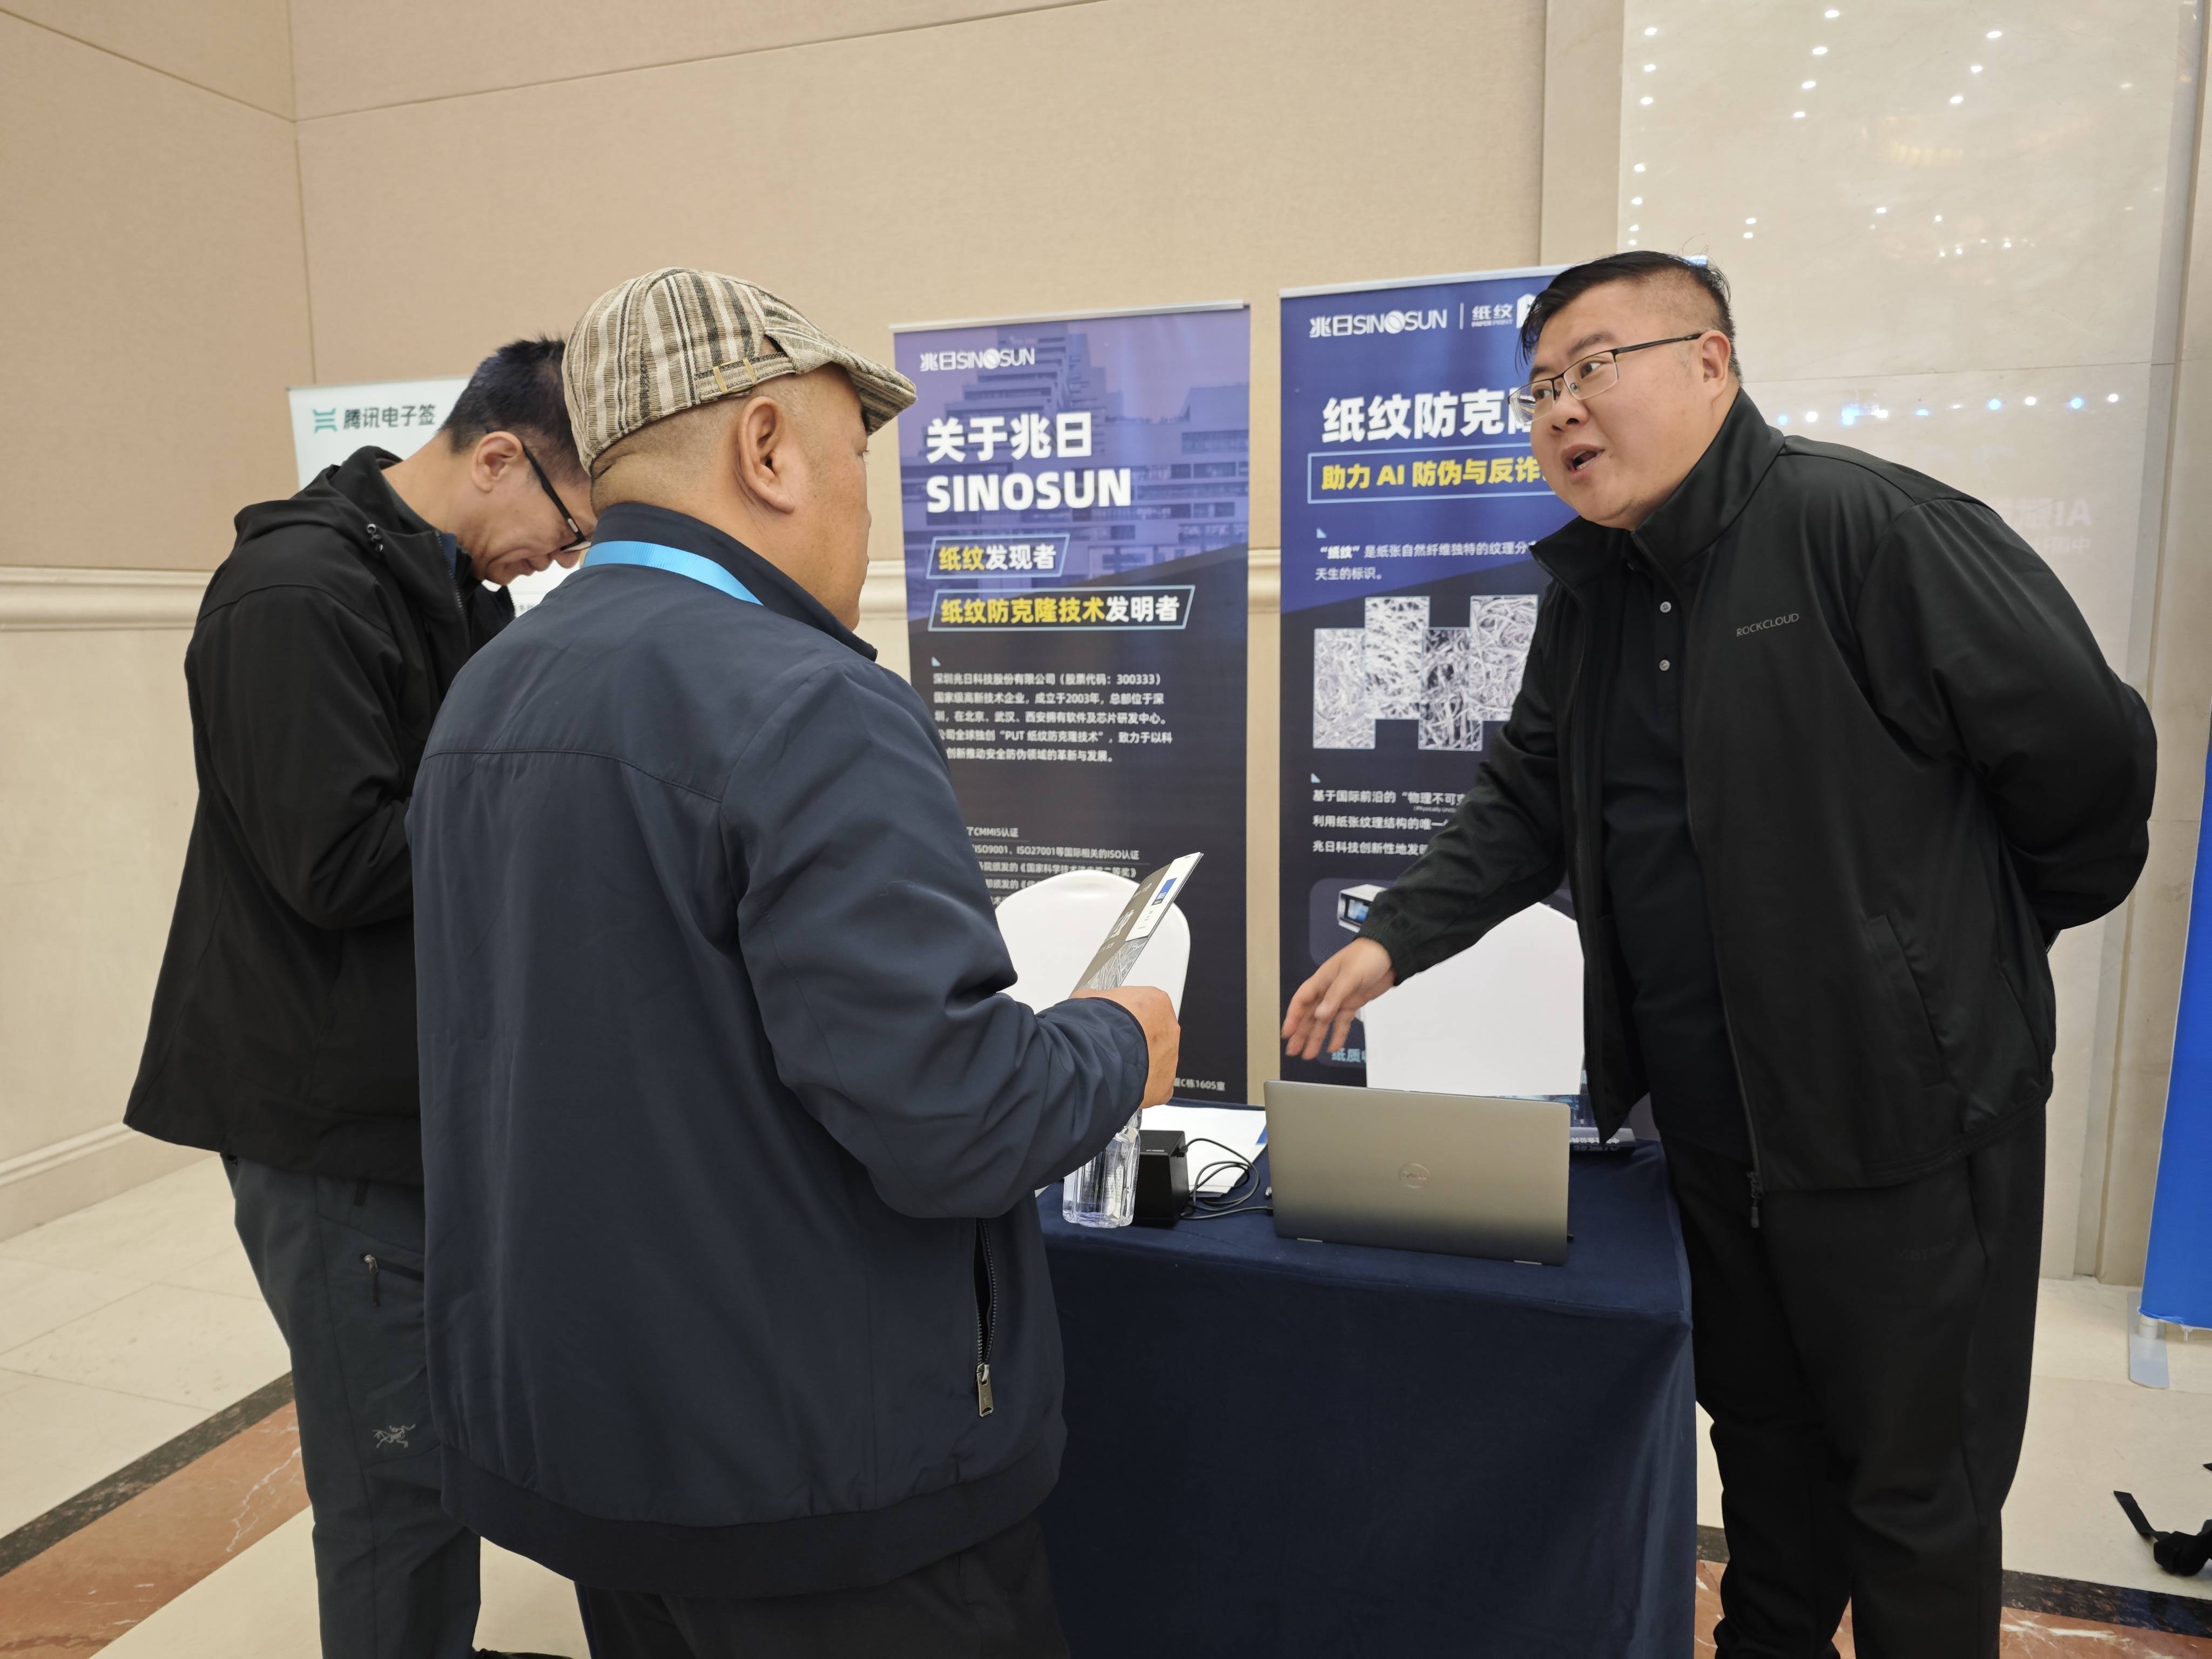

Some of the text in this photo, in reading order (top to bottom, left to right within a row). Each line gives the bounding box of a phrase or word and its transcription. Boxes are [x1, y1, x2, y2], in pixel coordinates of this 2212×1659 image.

[1472, 303, 1514, 320] 纸纹
[343, 404, 436, 430] 腾讯电子签
[926, 411, 1092, 463] 关于兆日
[1321, 456, 1546, 490] 助力 AI 防伪与反诈
[926, 468, 1131, 514] SINOSUN
[938, 543, 1057, 571] 纸纹发现者
[1320, 540, 1537, 559] “纸纹”是纸张自然纤维独特的纹理分
[1316, 567, 1382, 581] 天生的标识。
[940, 595, 1180, 625] 纸纹防克隆技术发明者
[1736, 613, 1799, 637] ROCKCLOUD
[1313, 814, 1448, 831] 利用纸张纹理结构的唯一
[1331, 1048, 1366, 1063] 纸质
